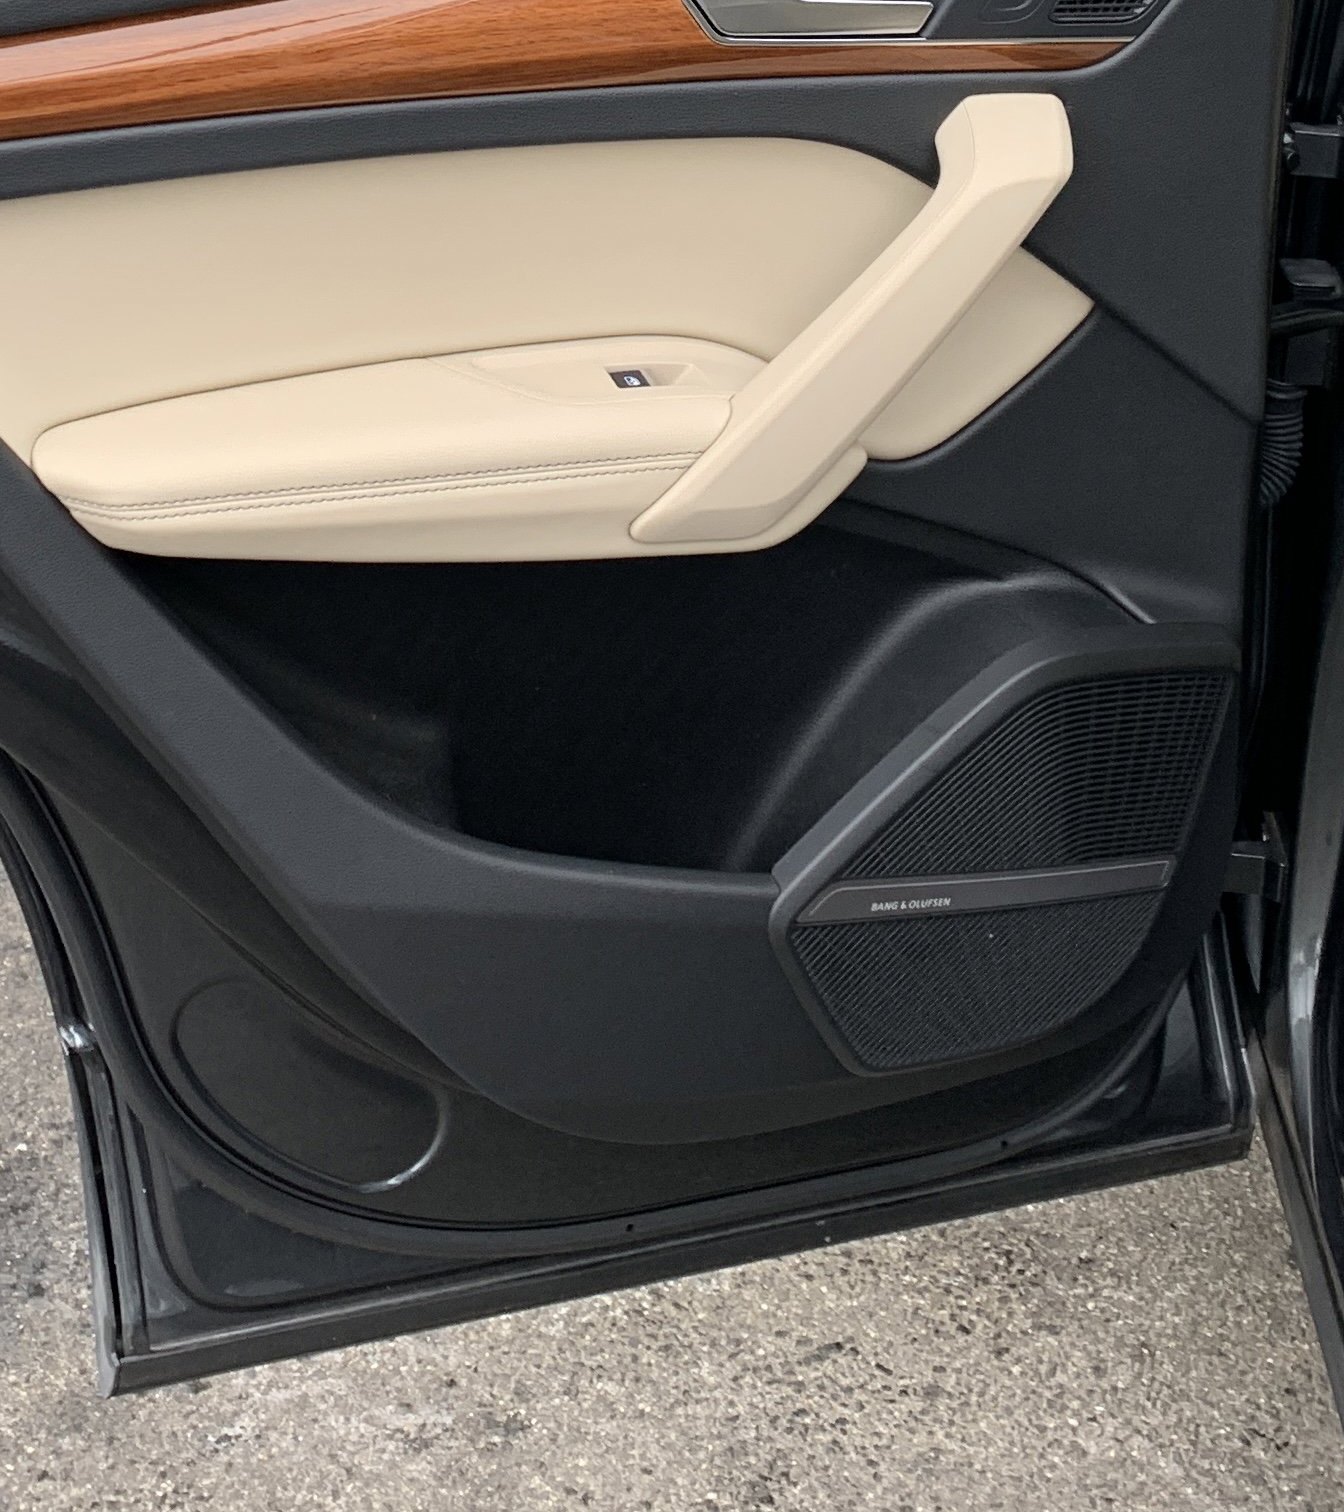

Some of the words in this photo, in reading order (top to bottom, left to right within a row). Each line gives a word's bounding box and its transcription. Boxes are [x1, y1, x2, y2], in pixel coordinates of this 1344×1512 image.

[871, 902, 899, 912] BANG
[900, 901, 907, 909] &
[908, 898, 951, 909] OLUFSEN
